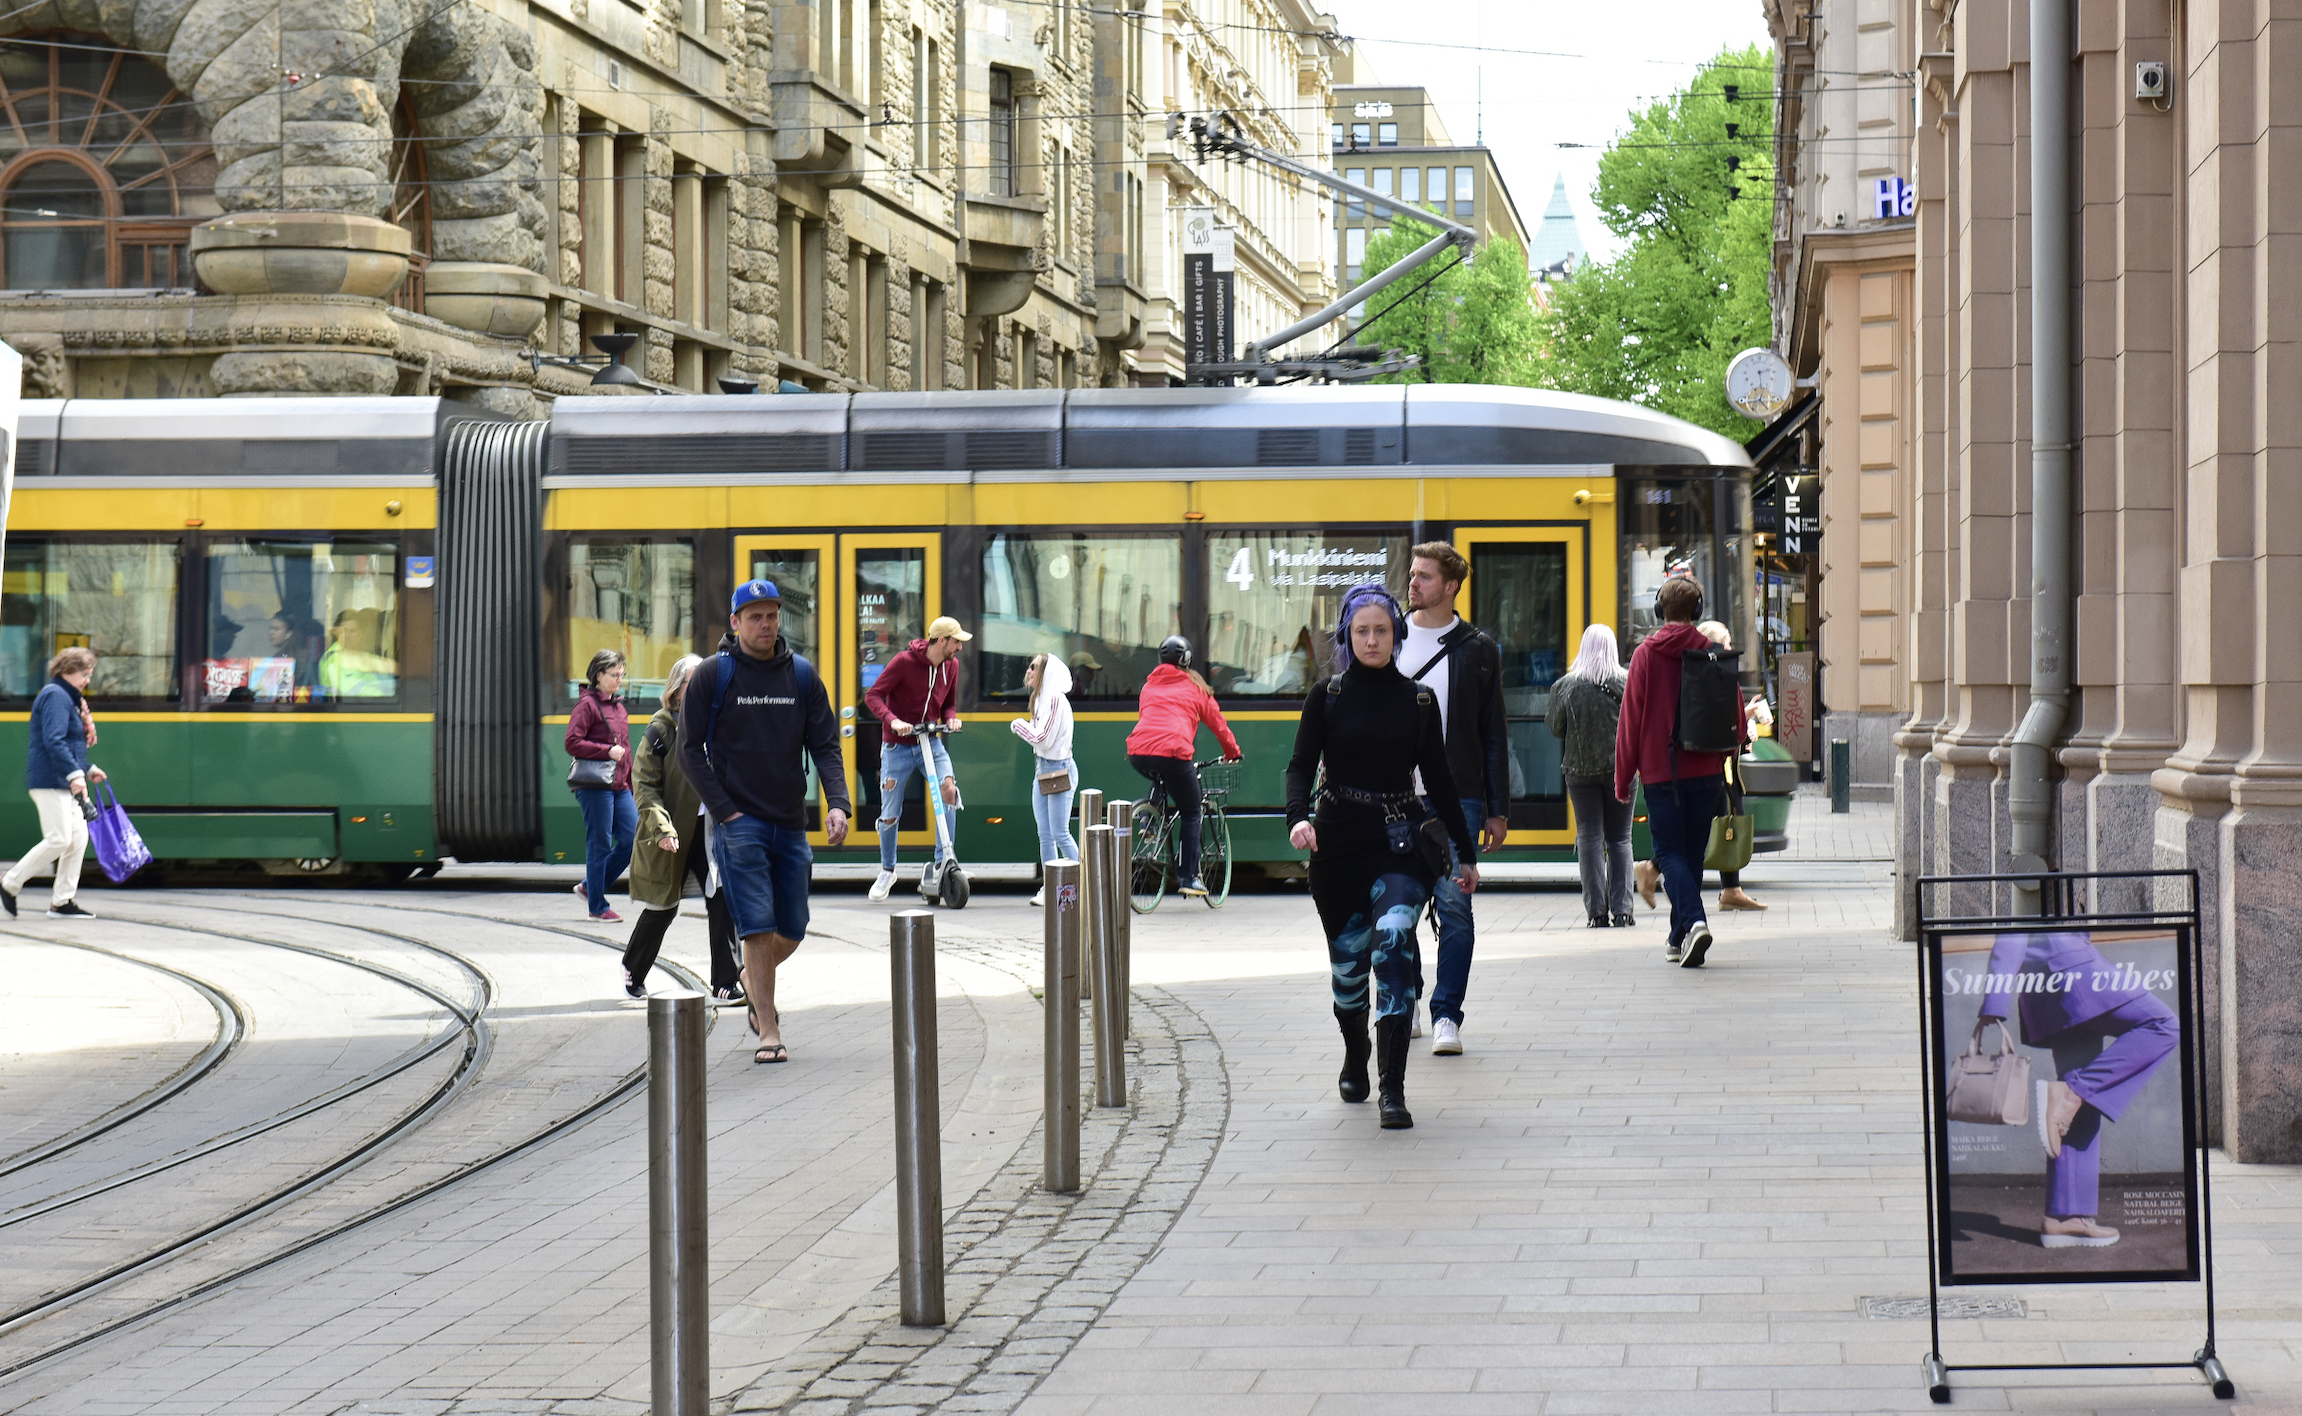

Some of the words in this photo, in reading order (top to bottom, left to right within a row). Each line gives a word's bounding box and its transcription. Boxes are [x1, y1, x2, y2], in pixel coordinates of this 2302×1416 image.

[1194, 260, 1204, 287] GIFTS
[1195, 294, 1204, 312] BAR
[1216, 278, 1225, 338] PHOTOGRAPHY
[1194, 320, 1204, 343] CAFÉ
[1784, 475, 1801, 554] VENN
[1225, 546, 1255, 592] 4
[1268, 571, 1295, 586] via
[929, 780, 940, 810] BIRD
[1942, 966, 2083, 996] Summer
[2091, 961, 2176, 993] vibes
[2123, 1191, 2143, 1199] ROSE
[2144, 1191, 2185, 1199] MOCCASIN
